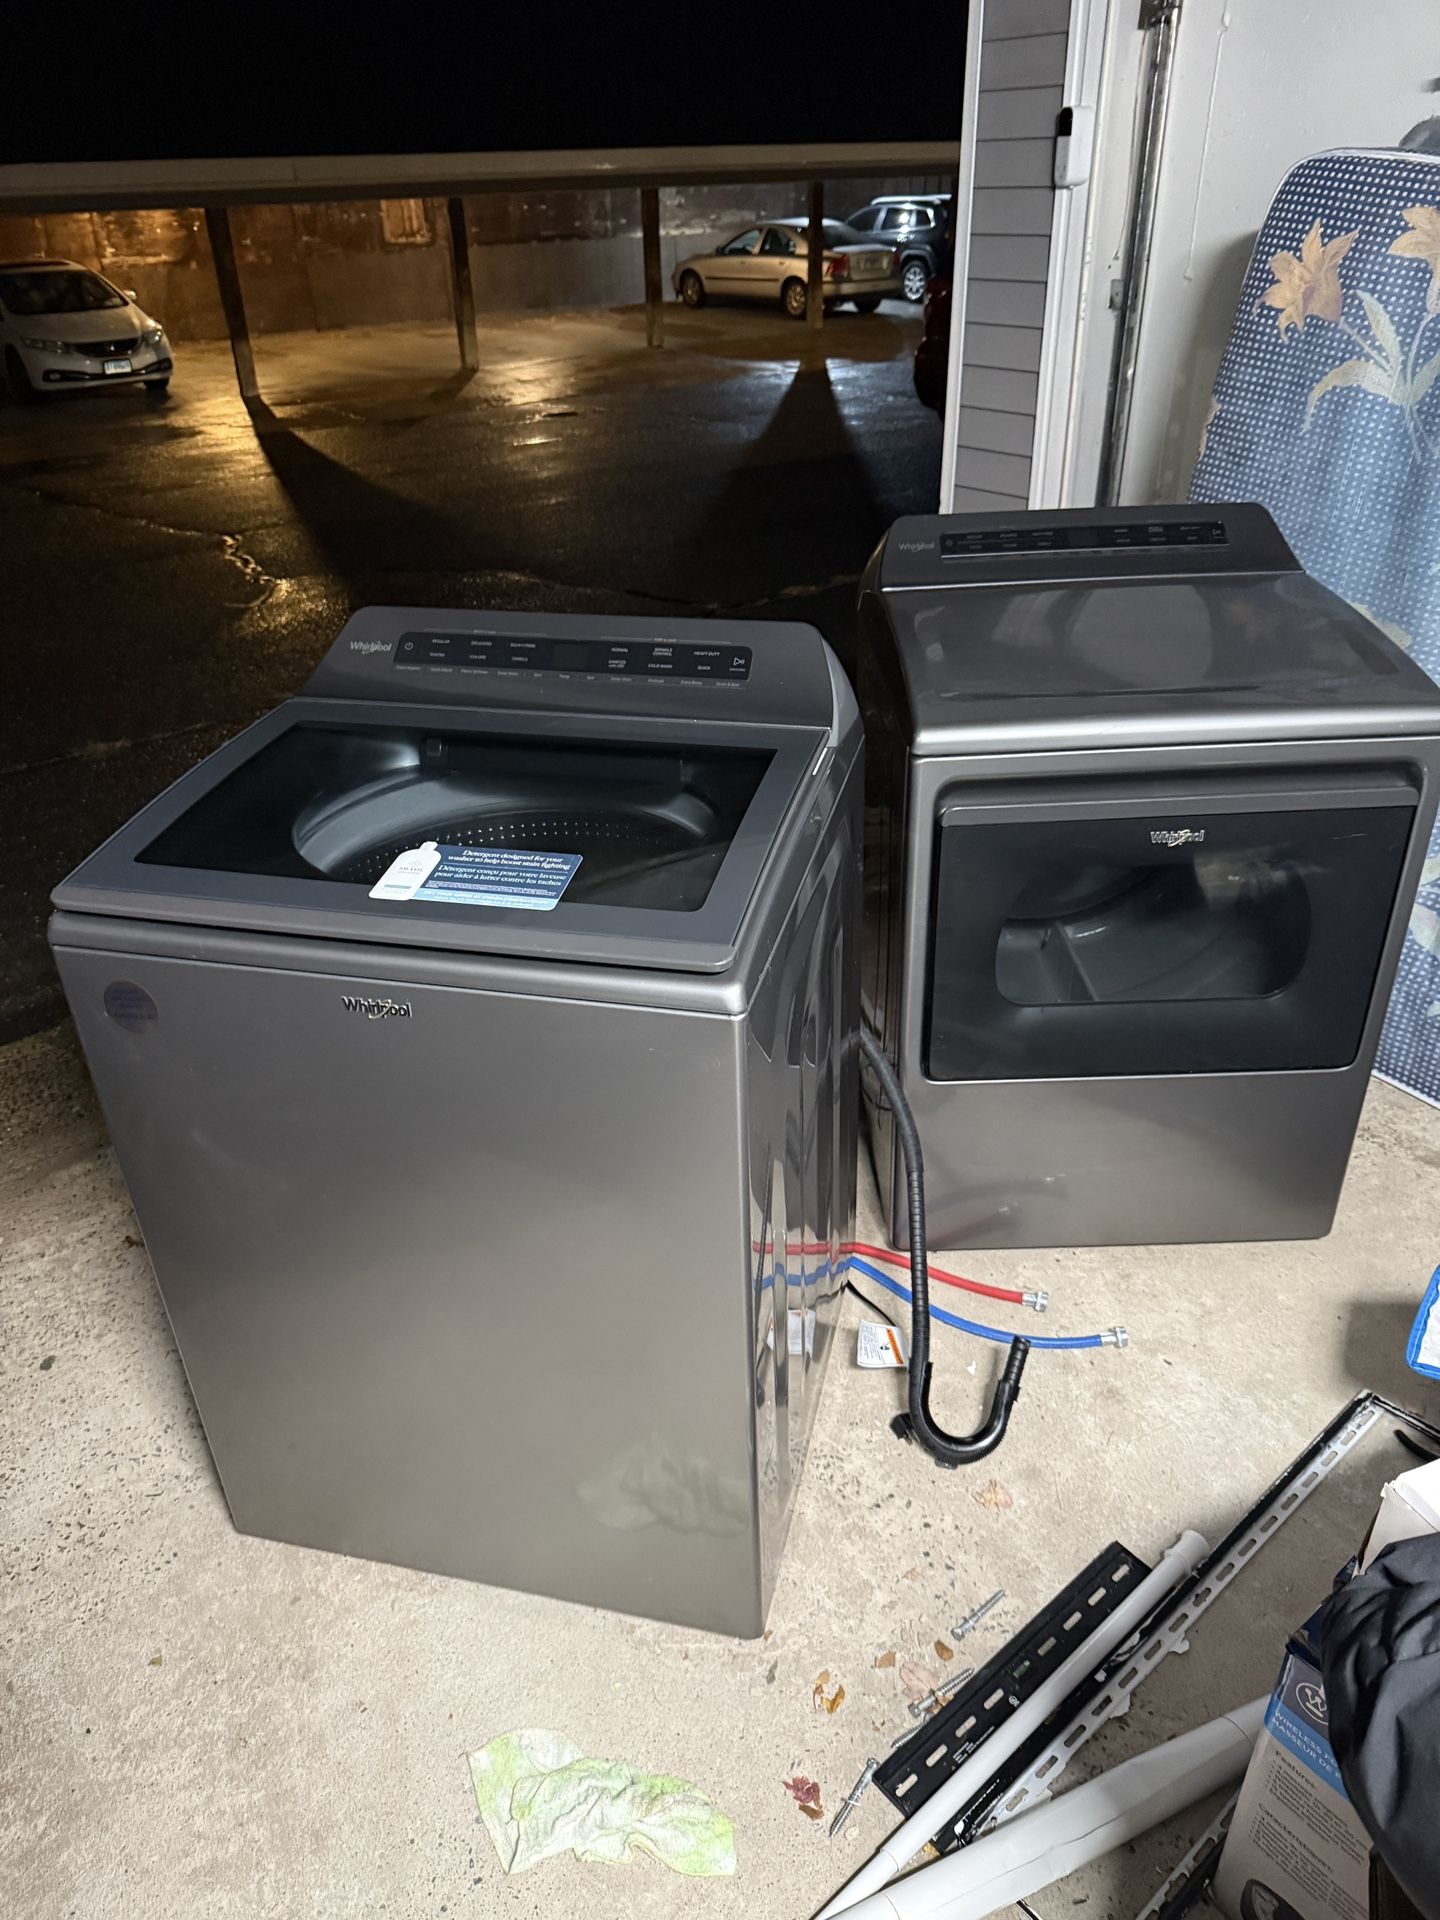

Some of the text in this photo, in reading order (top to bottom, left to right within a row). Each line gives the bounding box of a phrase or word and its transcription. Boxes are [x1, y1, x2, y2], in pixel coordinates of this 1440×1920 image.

[350, 640, 392, 654] Whirlpool
[1150, 829, 1205, 847] Whirlpool
[448, 854, 473, 862] washer
[483, 856, 500, 865] help
[501, 858, 522, 866] boost
[541, 861, 571, 870] fighting
[463, 850, 563, 864] Detergent designed for your
[434, 871, 453, 879] pour
[453, 871, 474, 879] aider
[537, 878, 562, 886] taches
[499, 869, 518, 877] pour
[539, 872, 566, 880] laveuse
[341, 996, 412, 1018] Whirlpool
[1272, 1717, 1317, 1759] MASSEUR
[1275, 1710, 1322, 1754] WIRELESS
